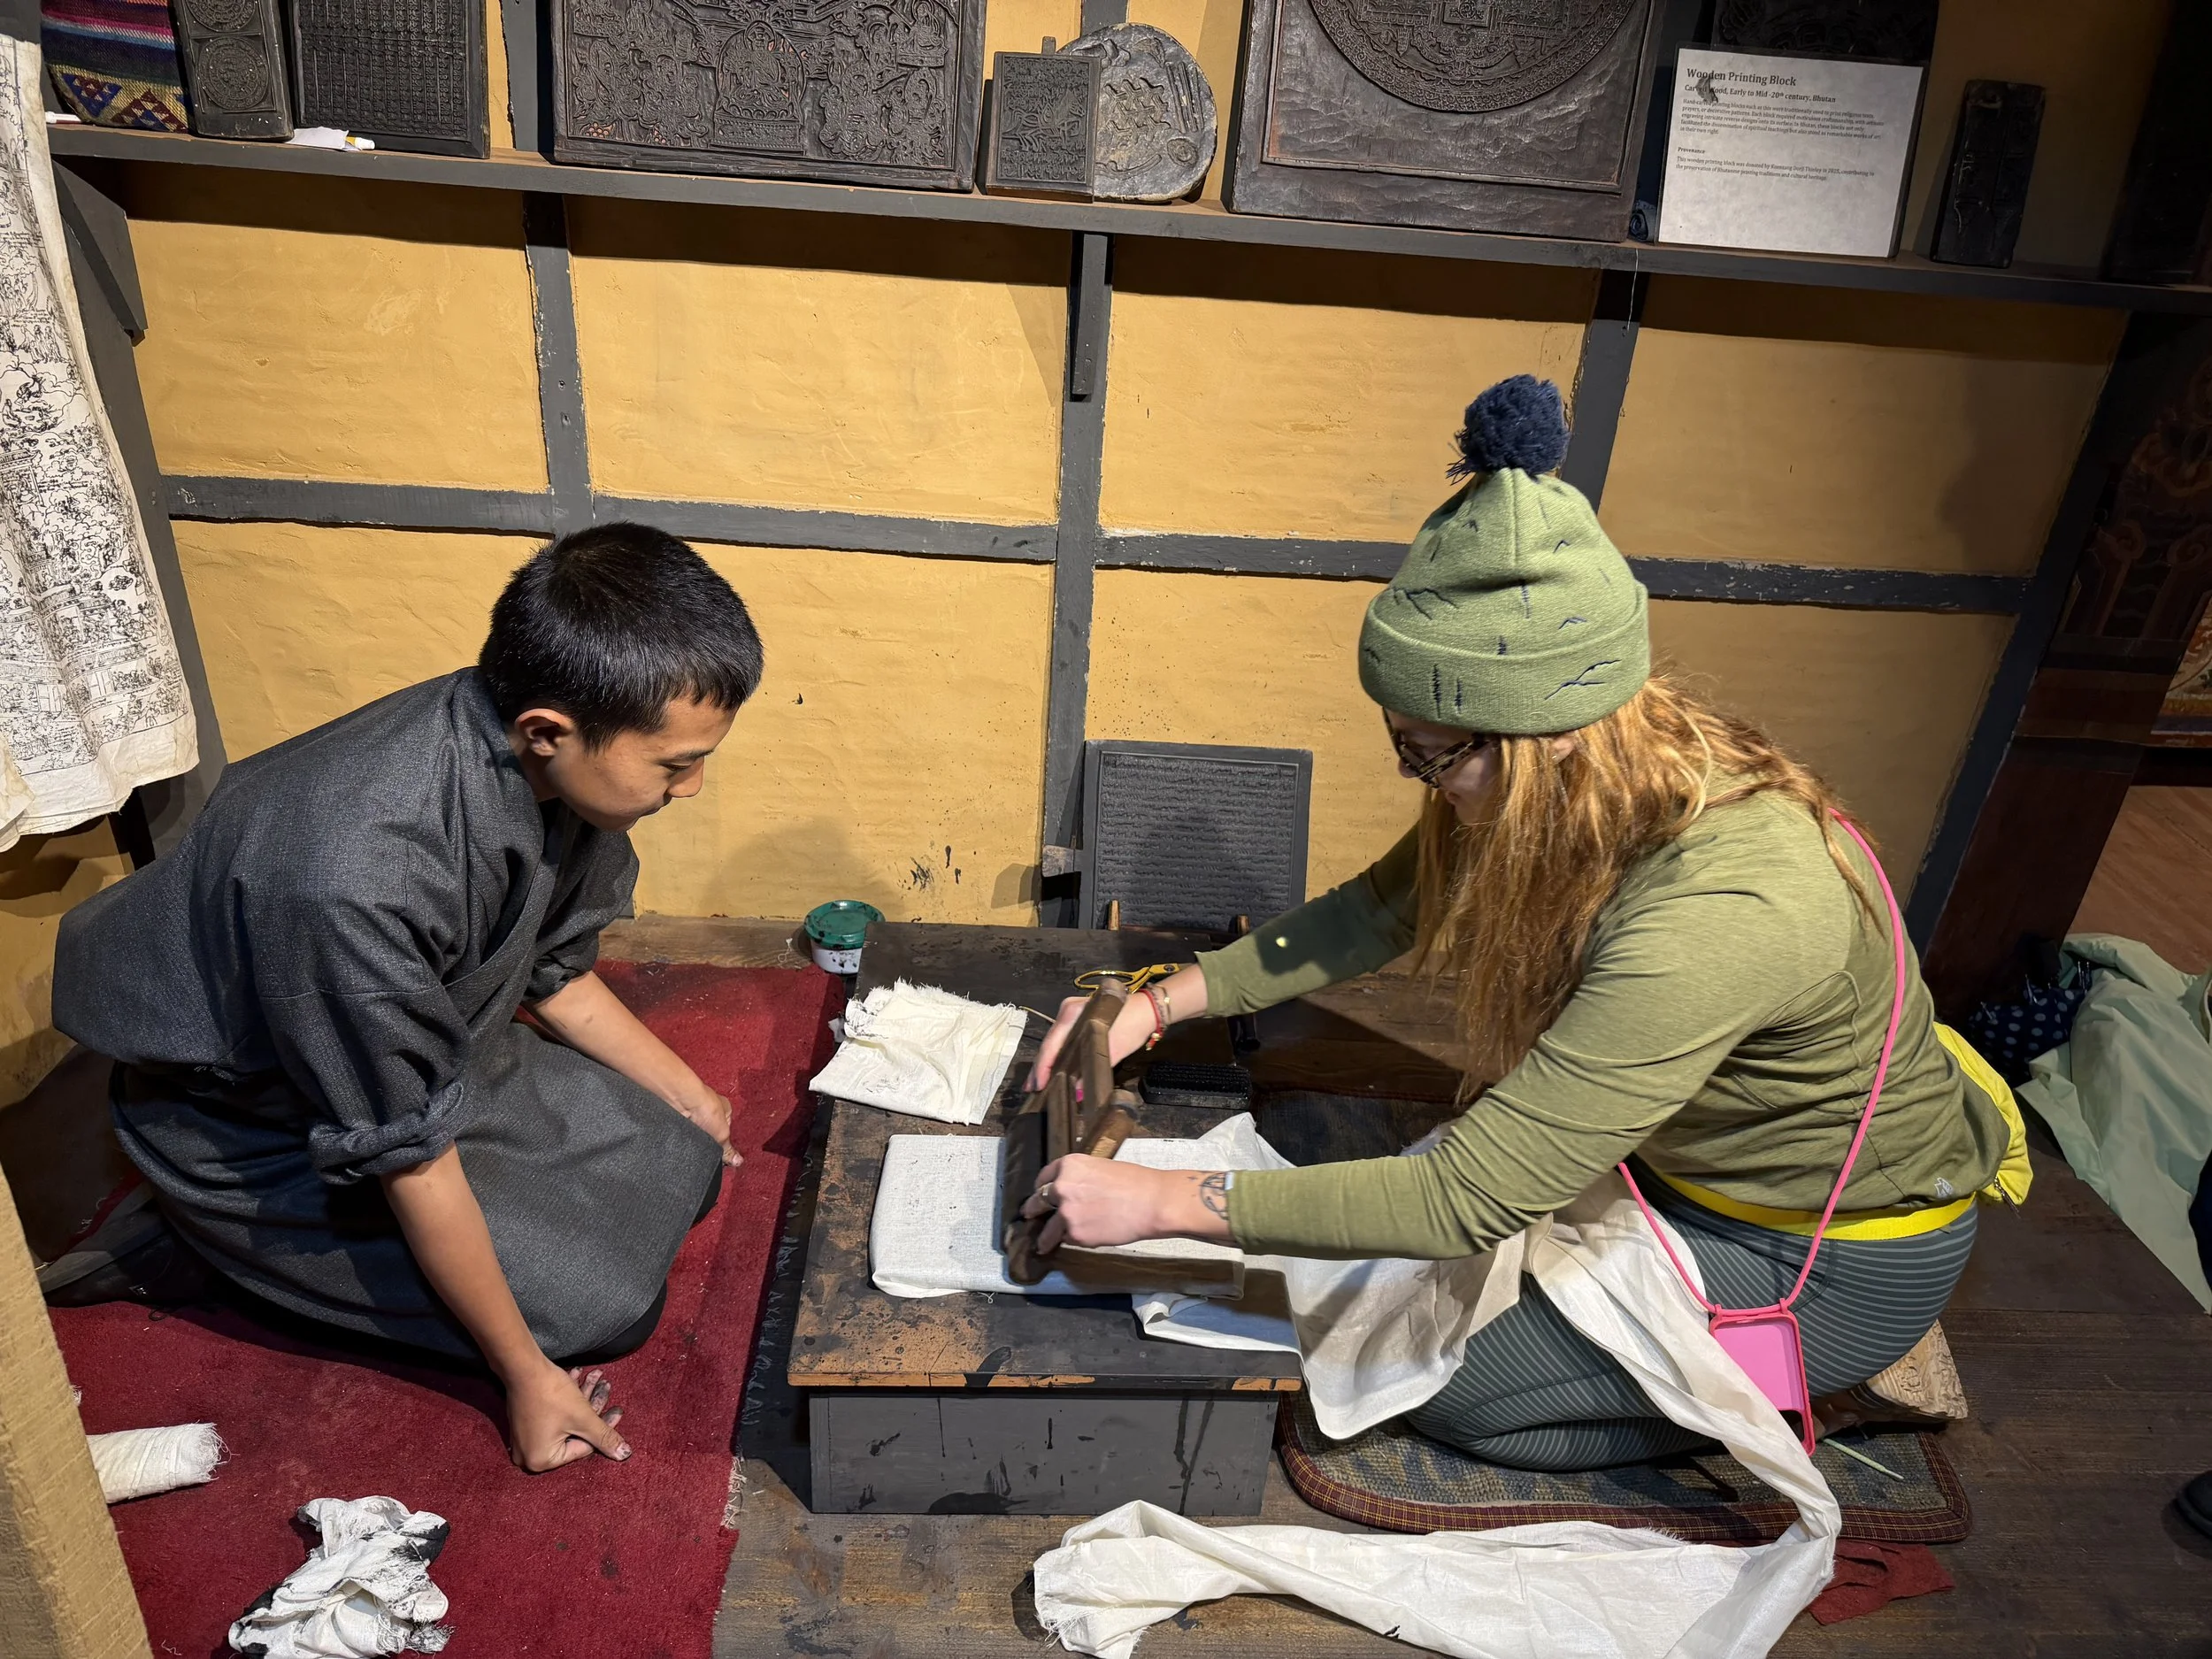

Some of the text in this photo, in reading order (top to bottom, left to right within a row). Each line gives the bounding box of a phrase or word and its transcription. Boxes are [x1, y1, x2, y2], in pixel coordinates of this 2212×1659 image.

[1686, 68, 1797, 87] Wooden Printing Block
[1730, 88, 1747, 97] Early
[1785, 93, 1812, 103] century,
